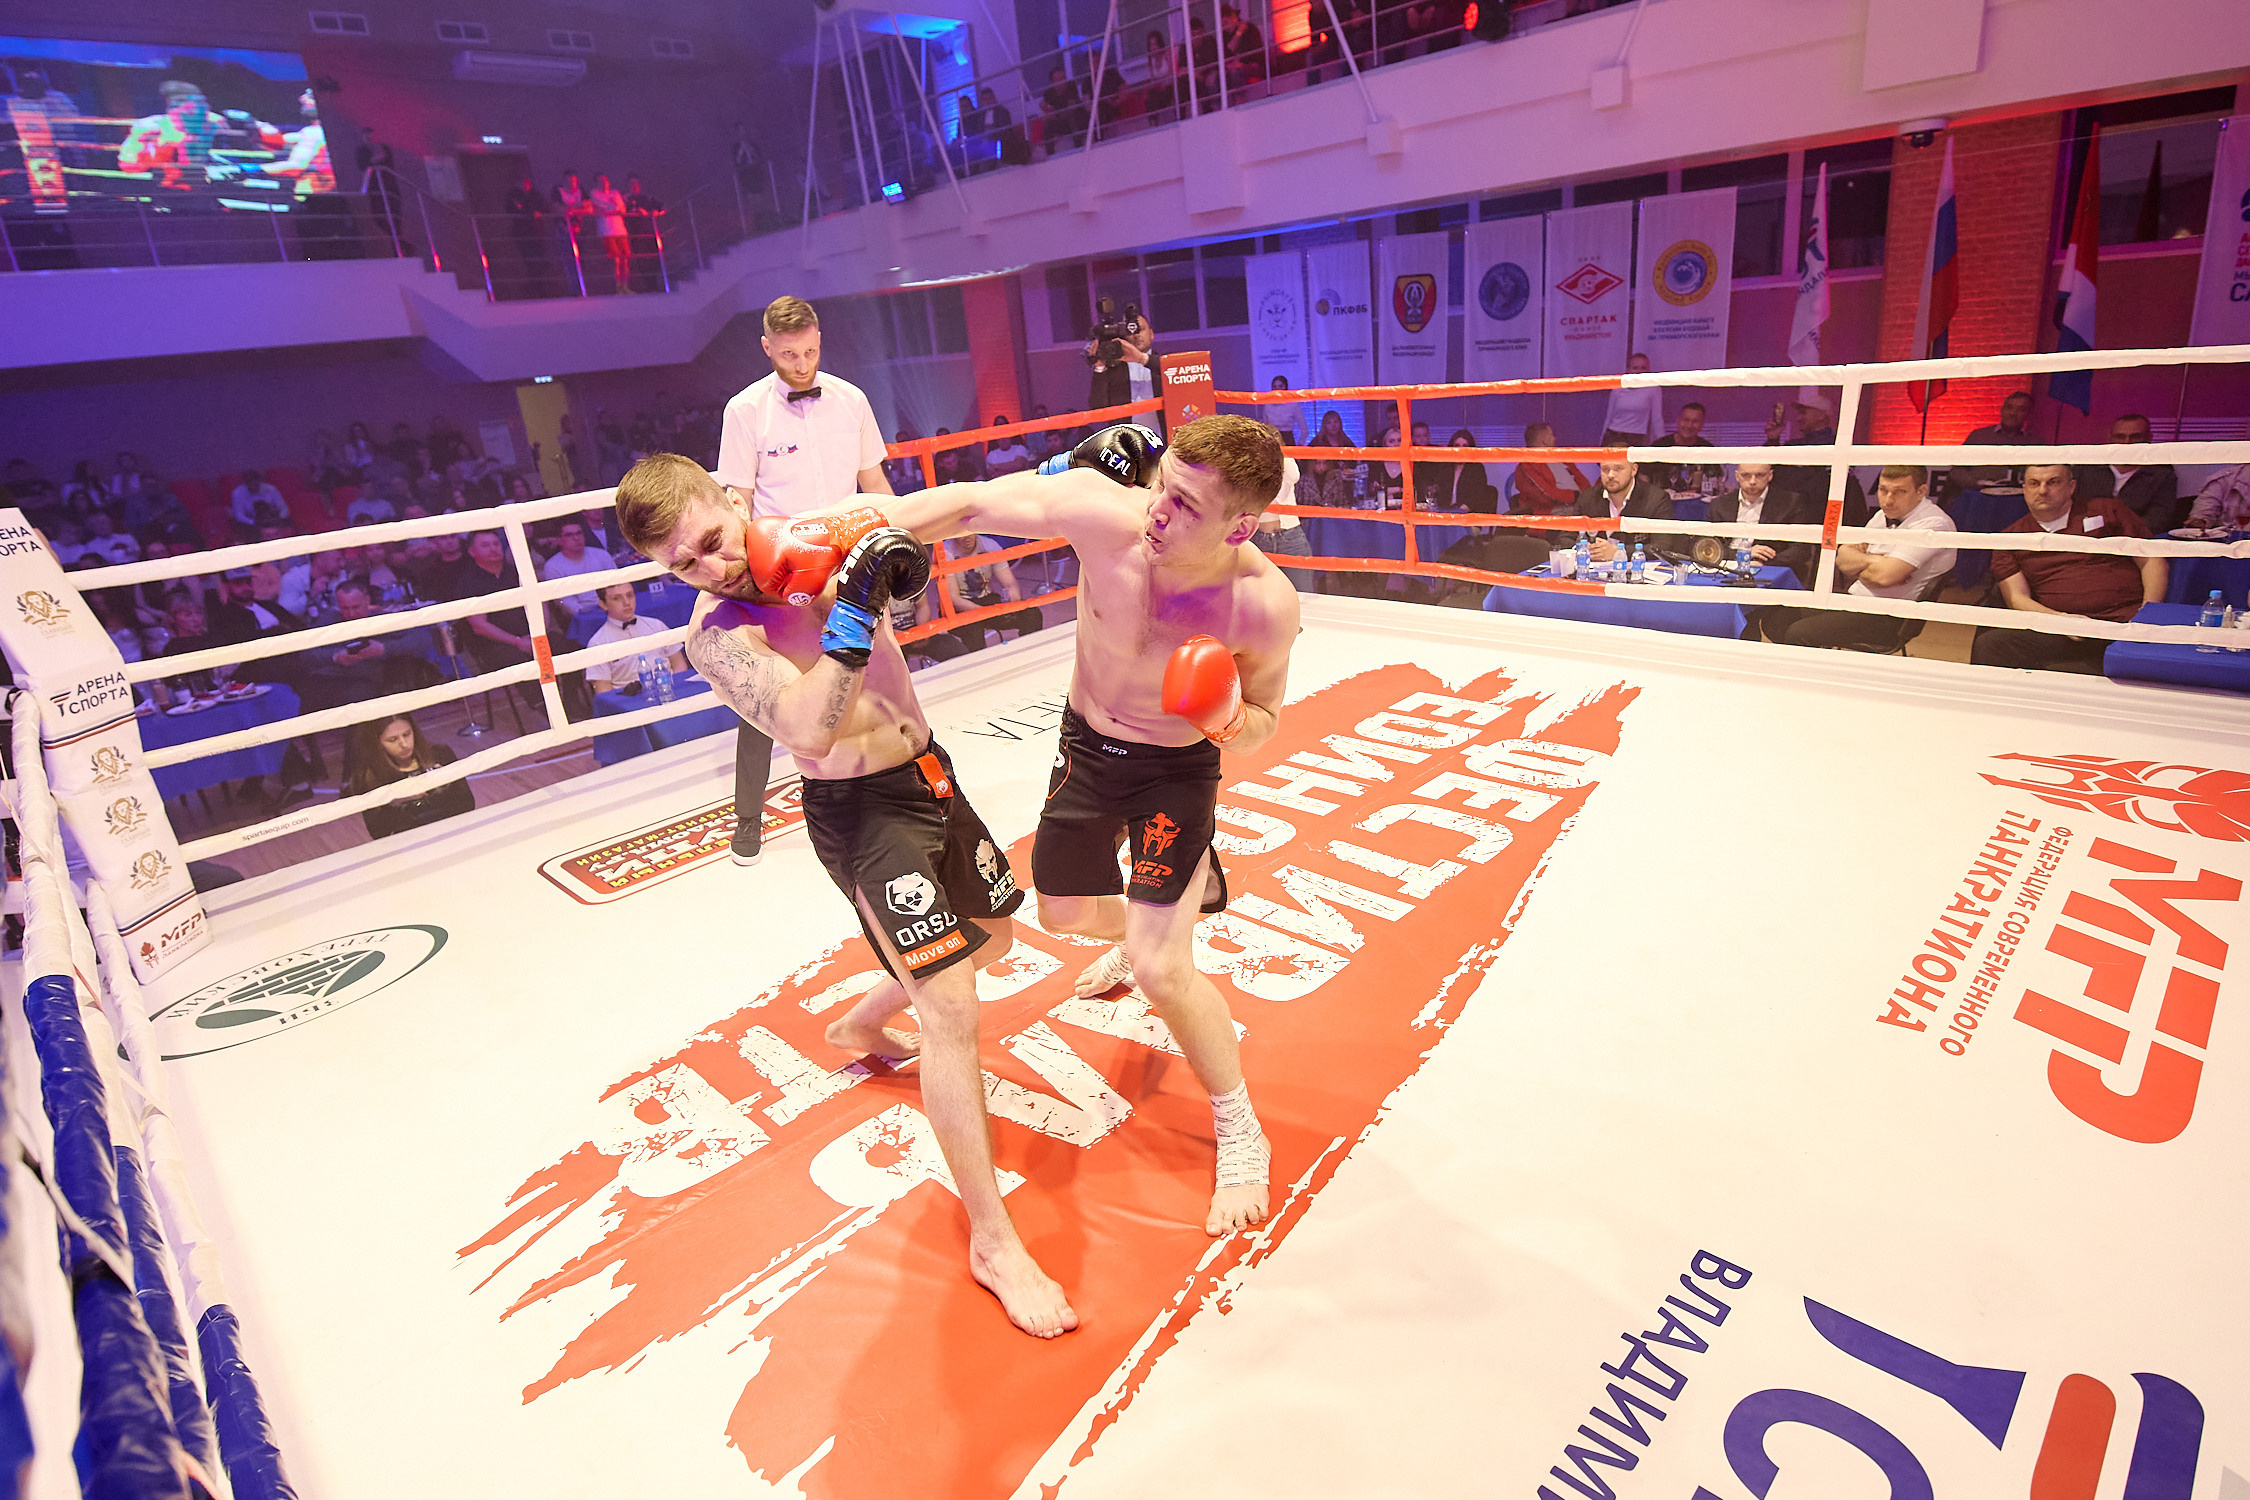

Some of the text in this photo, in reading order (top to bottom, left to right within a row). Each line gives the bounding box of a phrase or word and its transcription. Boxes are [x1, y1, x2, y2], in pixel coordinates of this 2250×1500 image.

[1560, 315, 1617, 326] СПАРТАК
[1172, 373, 1211, 385] СПОРТА
[1178, 364, 1210, 375] АРЕНА
[1099, 446, 1131, 476] IDEAL
[1824, 502, 1842, 538] SPARTA
[77, 671, 126, 696] АРЕНА
[69, 686, 129, 715] СПОРТА
[1102, 743, 1128, 756] MFP
[161, 912, 202, 948] MFP
[1875, 809, 2042, 1033] ПАНКРАТИОНА
[904, 936, 960, 967] Move on
[1939, 826, 2074, 1057] ФЕДЕРАЦИЯ СОВРЕМЕННОГО
[2012, 836, 2244, 1145] MFP
[1537, 1249, 1753, 1500] ВЛАДИМ
